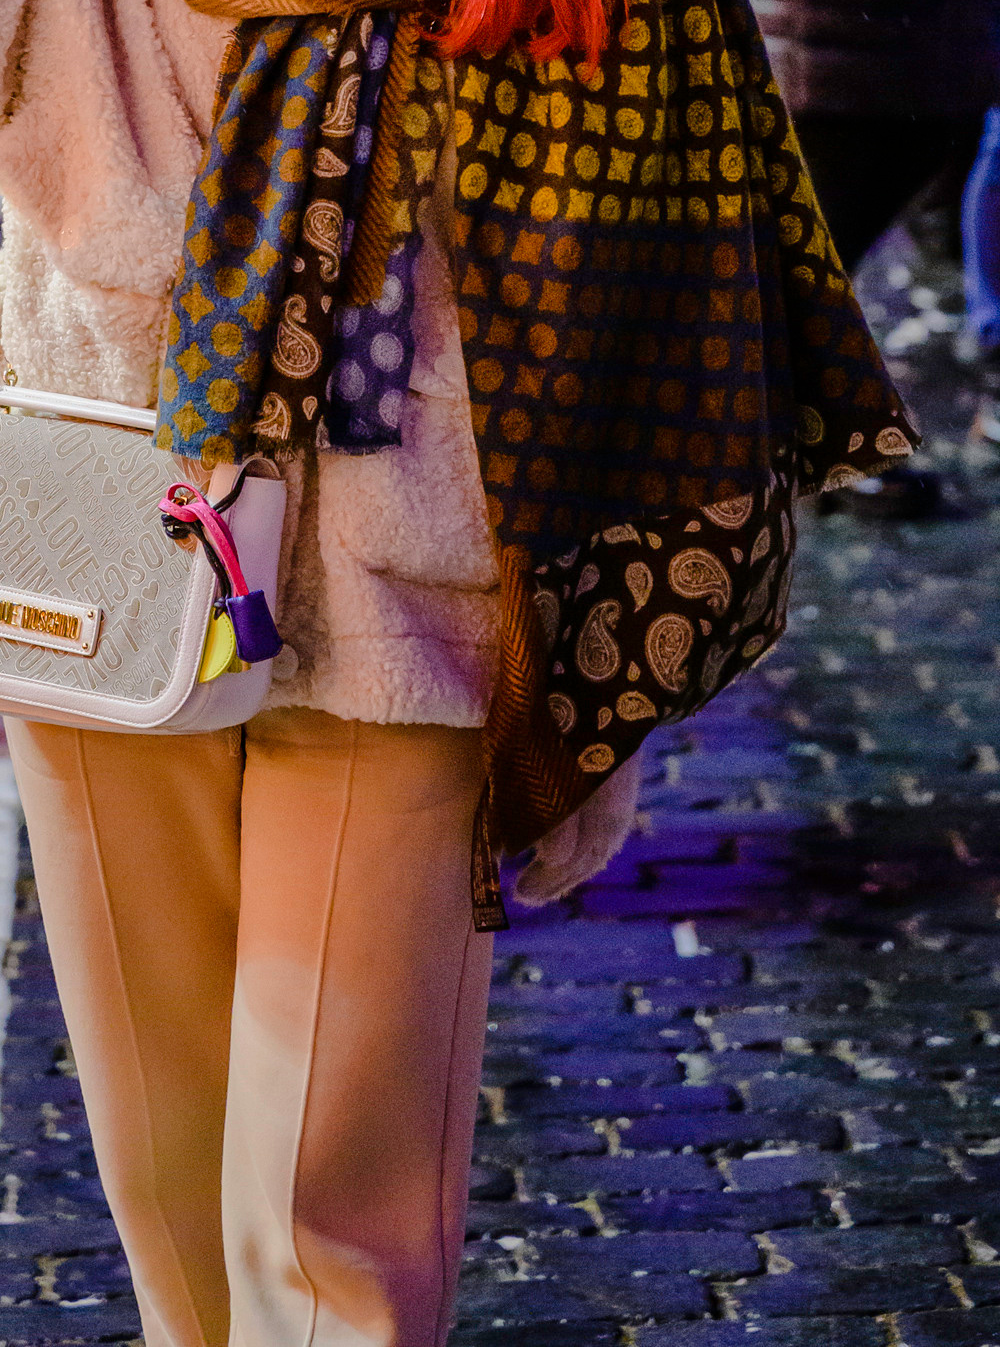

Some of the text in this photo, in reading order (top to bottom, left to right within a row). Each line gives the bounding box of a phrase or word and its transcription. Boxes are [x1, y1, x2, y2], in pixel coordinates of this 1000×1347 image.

[47, 420, 97, 478] LOV
[72, 473, 121, 558] MOSCHINO
[109, 494, 140, 544] LOVE
[37, 496, 100, 594] LOVE
[160, 551, 193, 589] LOV
[21, 605, 82, 640] MOSCHINO
